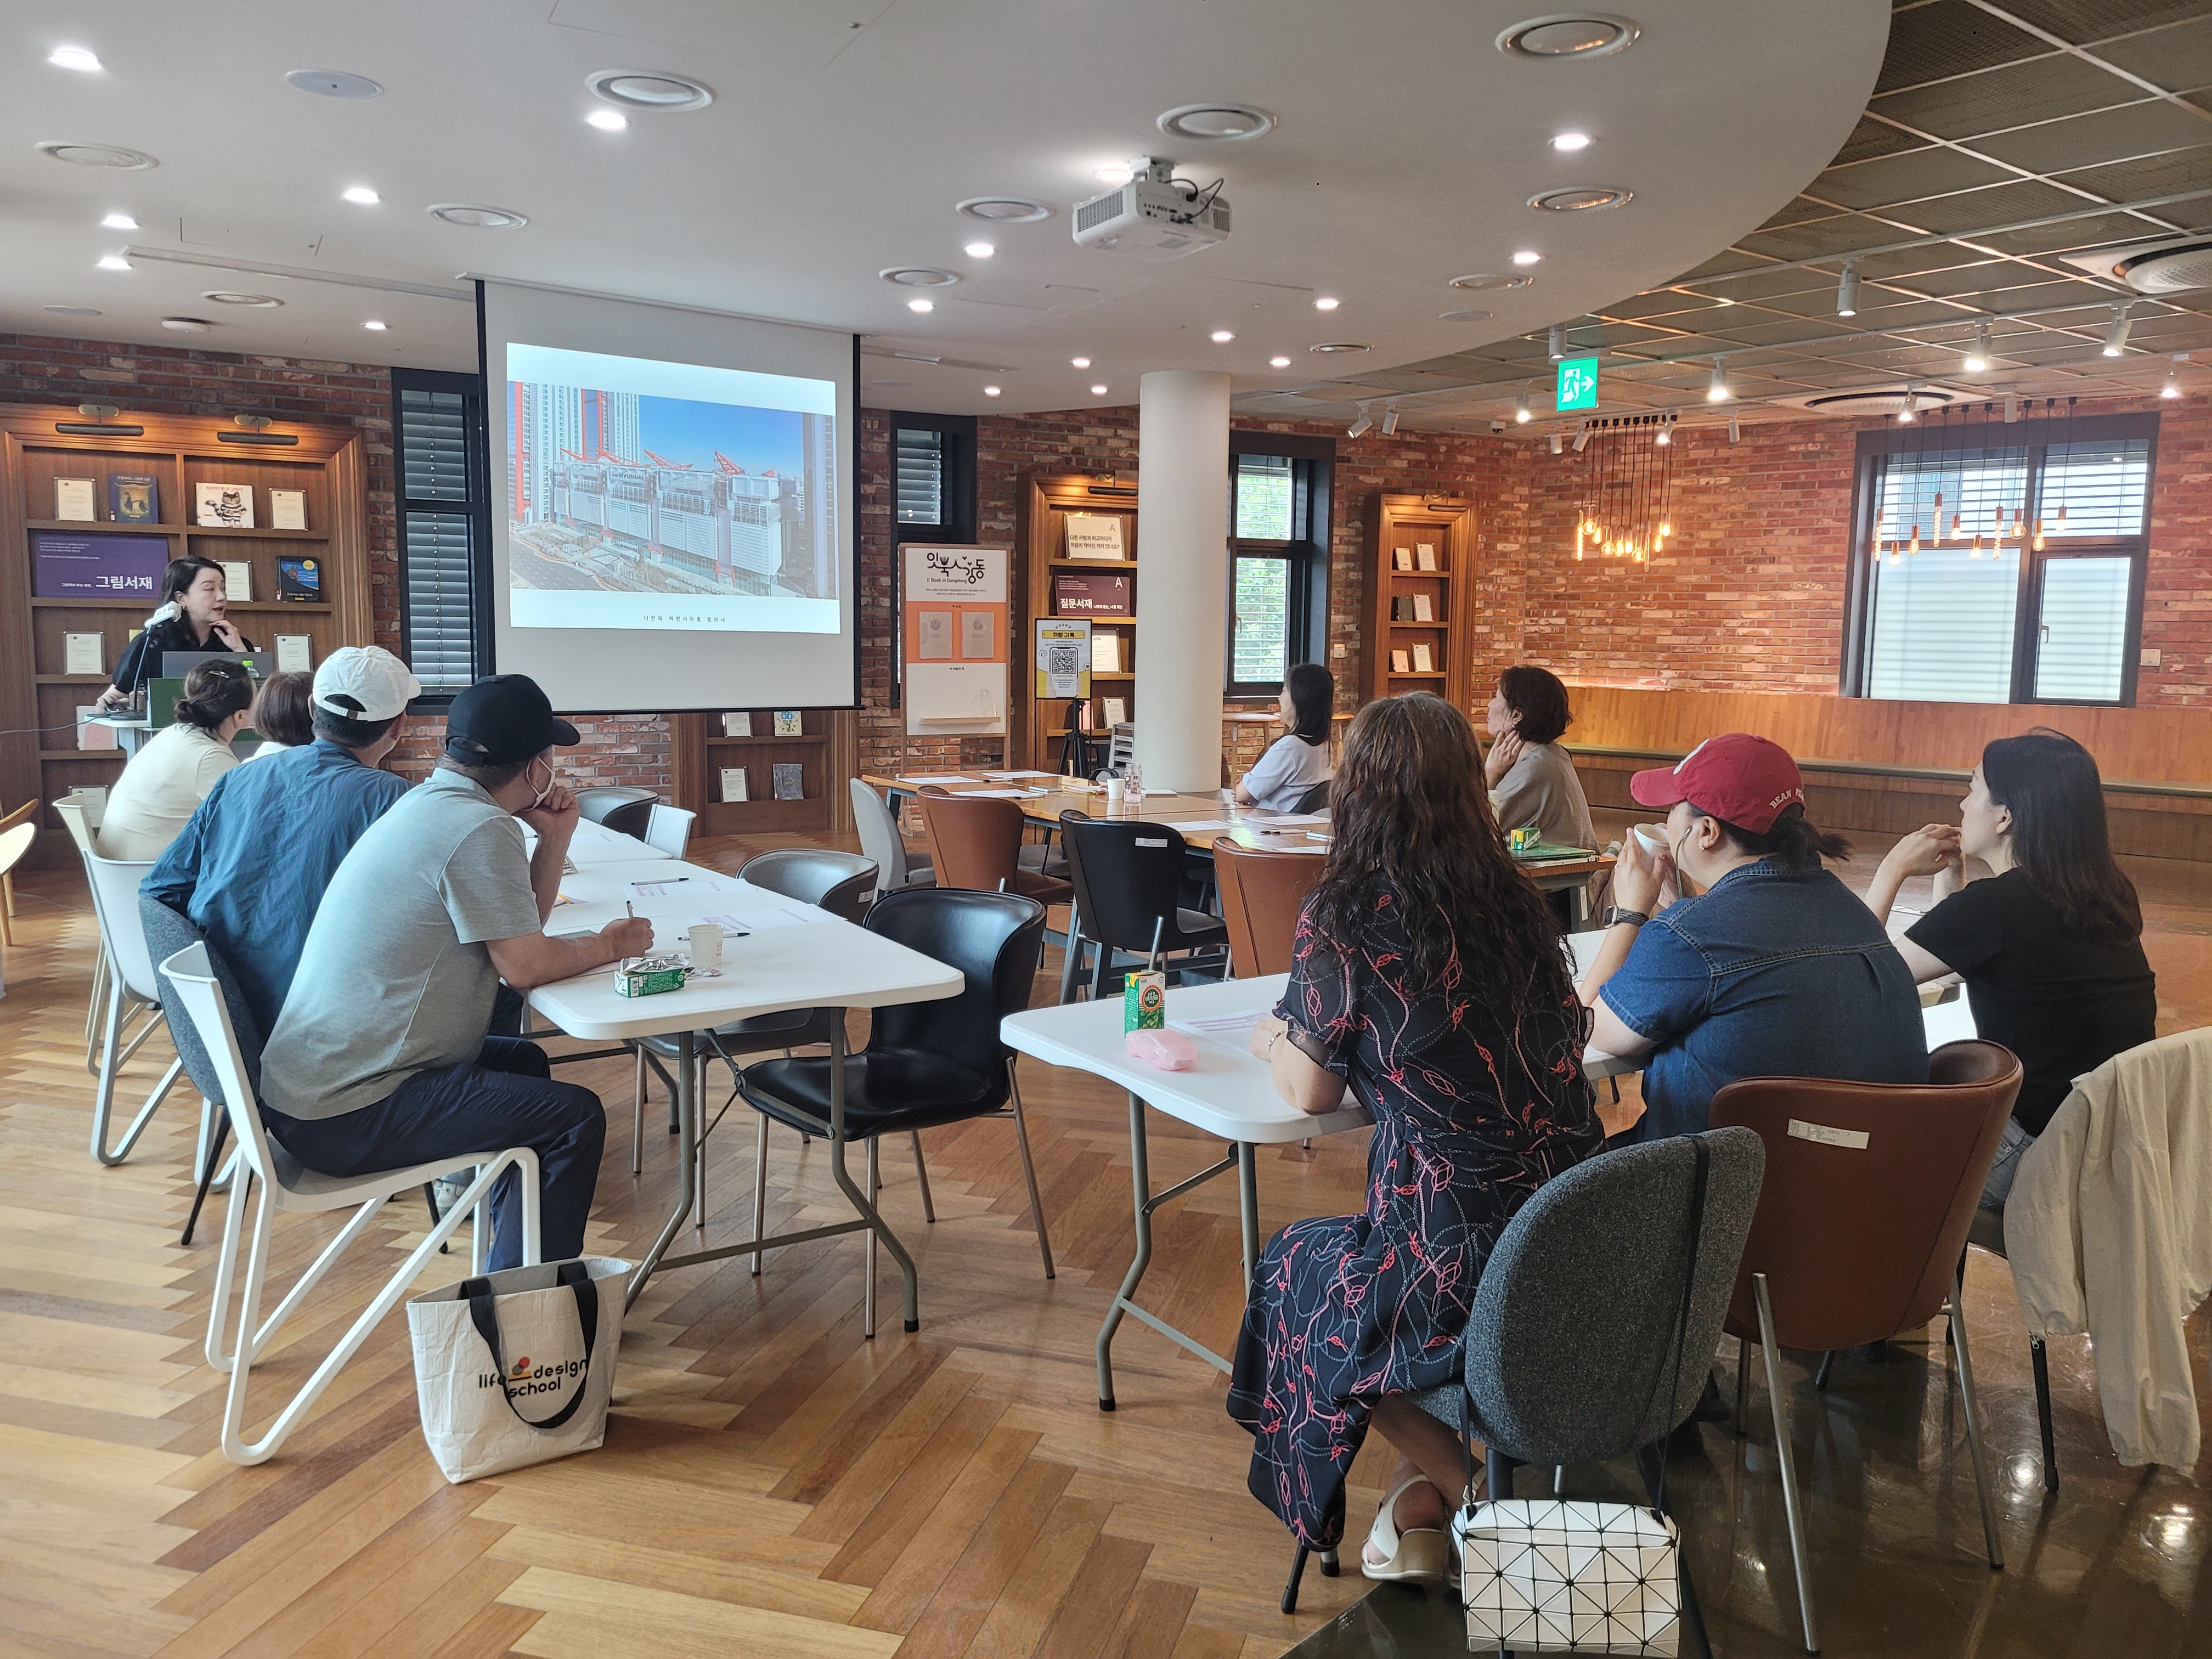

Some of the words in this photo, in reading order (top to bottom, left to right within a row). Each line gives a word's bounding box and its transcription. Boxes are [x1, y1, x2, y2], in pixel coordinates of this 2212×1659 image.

[95, 575, 153, 590] 그림서재
[1115, 577, 1123, 588] A
[1060, 597, 1093, 610] 질문서재
[1769, 789, 1792, 809] BEAN
[534, 1358, 587, 1379] design
[509, 1376, 561, 1398] school
